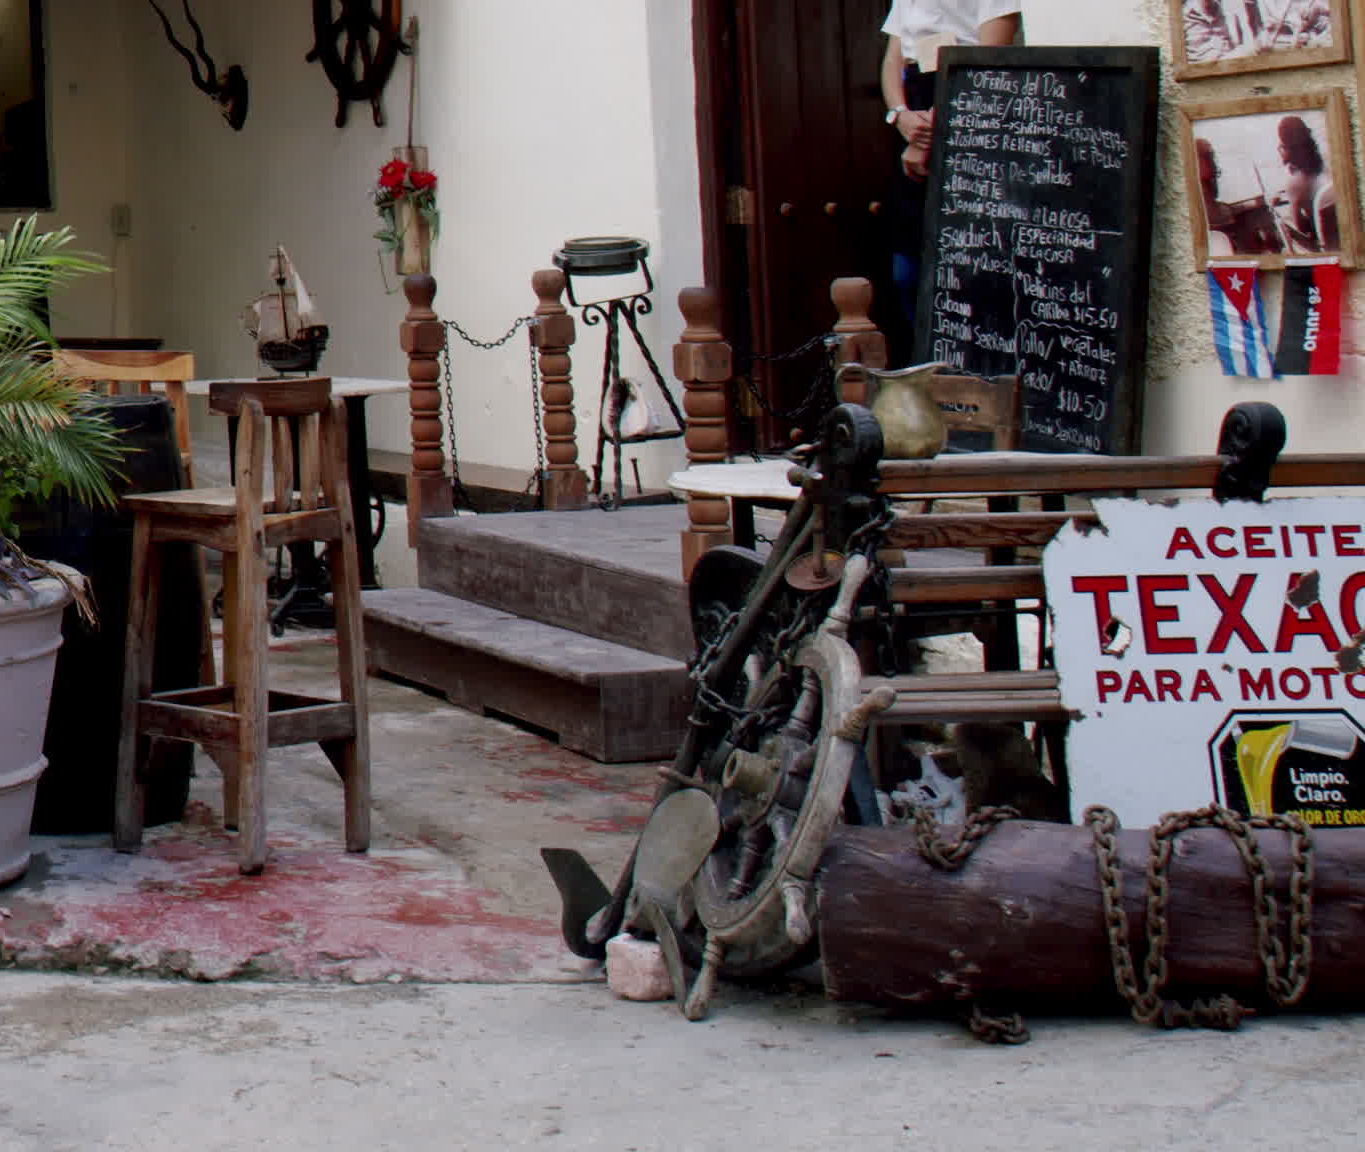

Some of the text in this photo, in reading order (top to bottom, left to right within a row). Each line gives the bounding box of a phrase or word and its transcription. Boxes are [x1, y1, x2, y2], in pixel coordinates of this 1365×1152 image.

[1302, 286, 1323, 352] 26 JULIO
[1056, 385, 1108, 422] $10.50
[1165, 524, 1365, 560] ACEITE
[1096, 668, 1223, 704] PARA
[1294, 785, 1348, 803] Claro.
